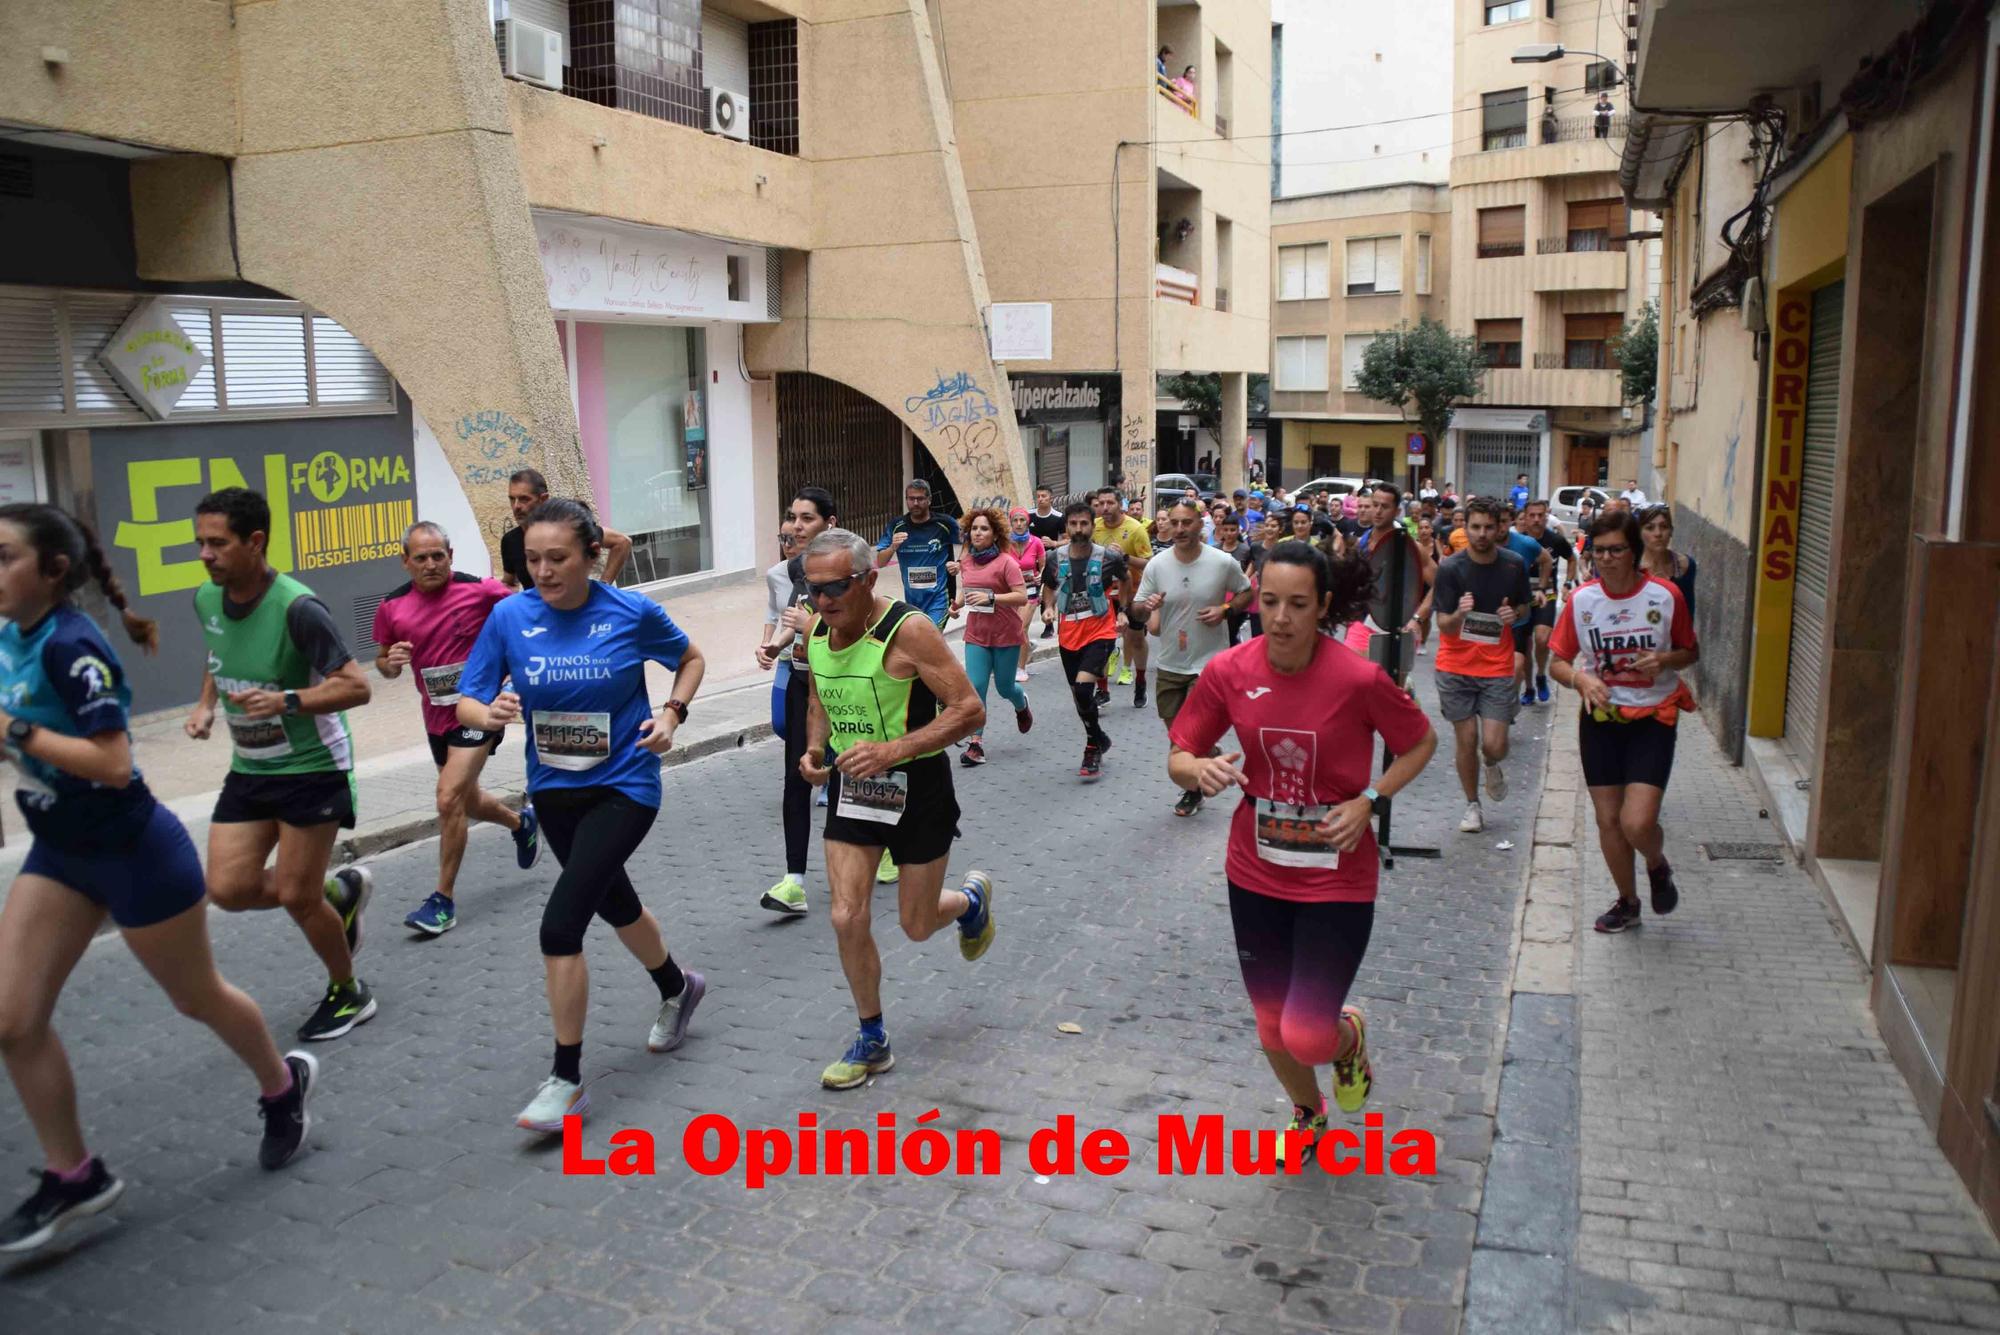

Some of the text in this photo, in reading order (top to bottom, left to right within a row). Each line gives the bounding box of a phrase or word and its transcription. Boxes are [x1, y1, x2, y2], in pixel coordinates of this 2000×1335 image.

[1010, 380, 1101, 417] Hipercalzados
[1764, 301, 1807, 582] CORTINAS
[307, 549, 352, 570] DESDE
[547, 655, 591, 667] VINOS
[546, 667, 612, 685] JUMILLA
[545, 726, 600, 745] 1155
[851, 781, 900, 800] 1047
